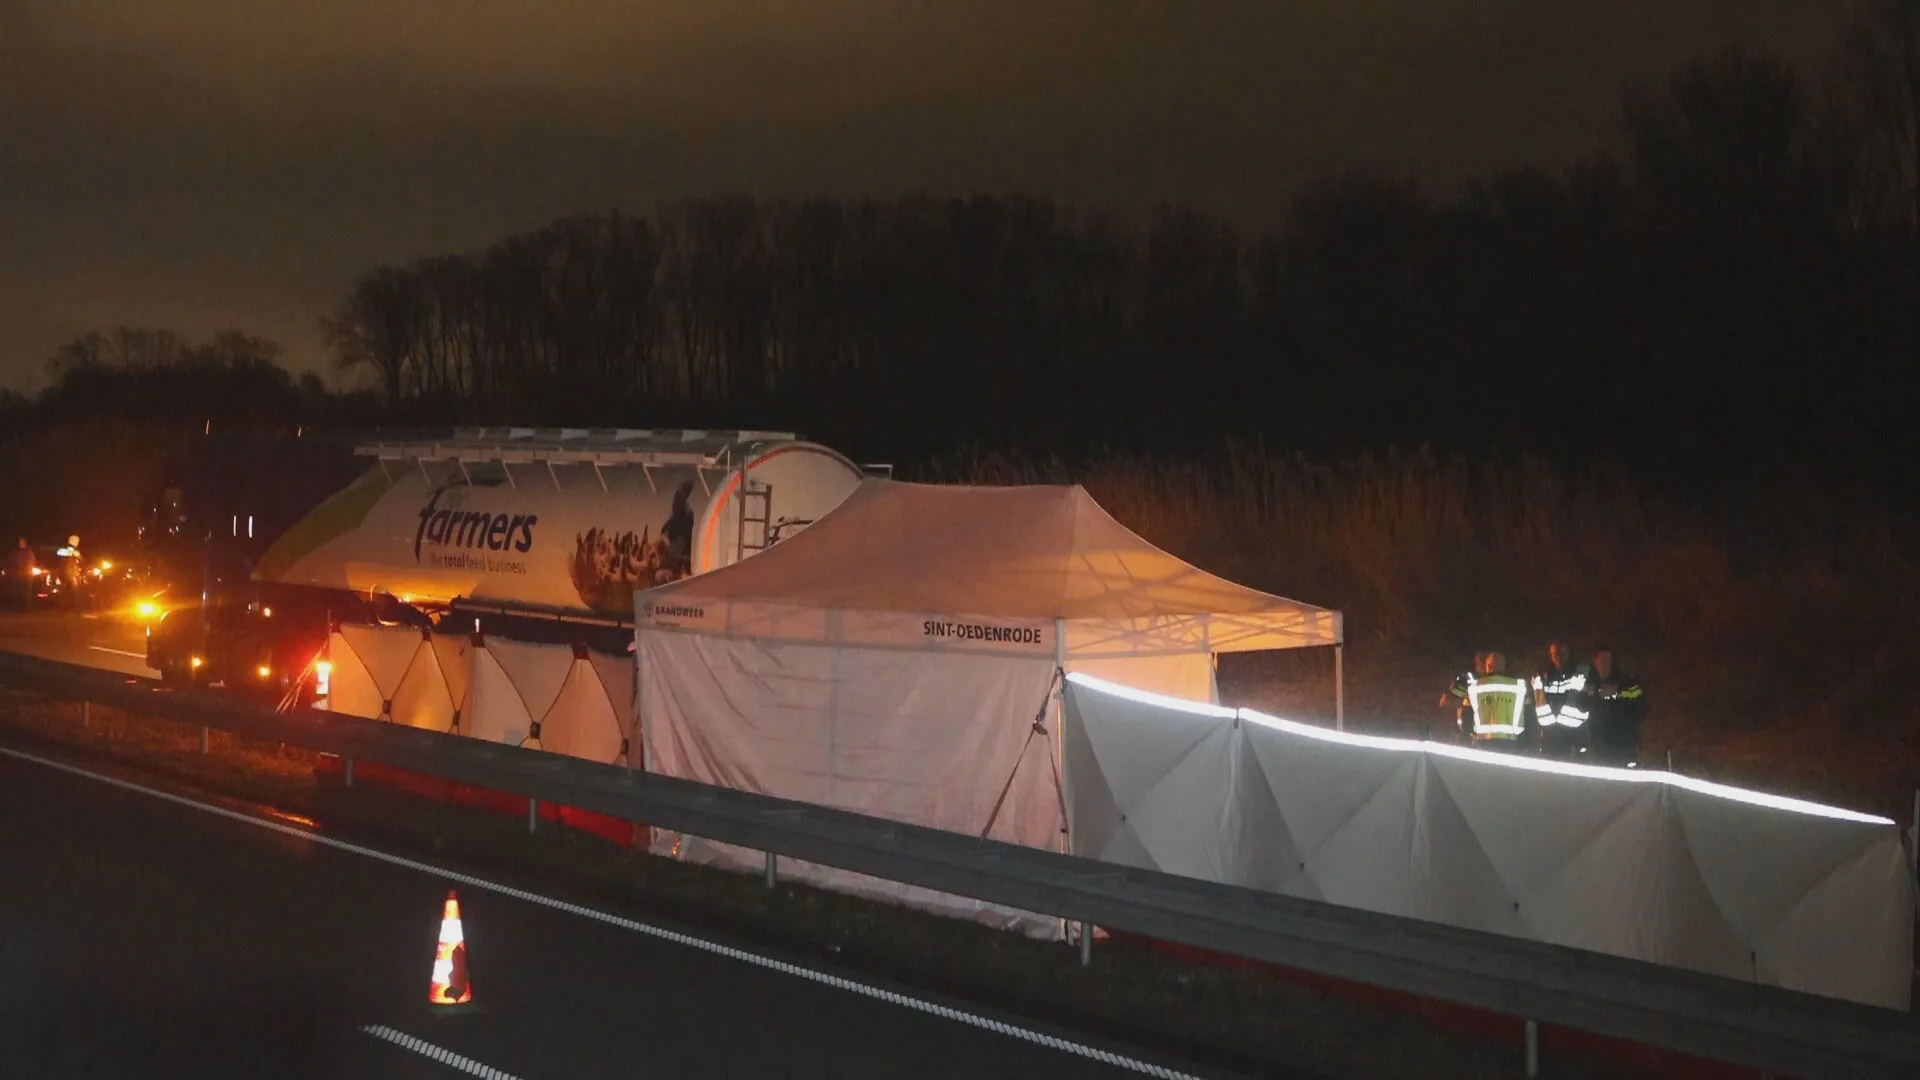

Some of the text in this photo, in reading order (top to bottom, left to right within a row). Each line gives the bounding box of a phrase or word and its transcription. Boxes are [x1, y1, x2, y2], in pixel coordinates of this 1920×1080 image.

[414, 487, 538, 563] farmers
[444, 553, 465, 569] total
[656, 606, 704, 618] BRANDWEER
[924, 620, 1041, 643] SINT-OEDENRODE
